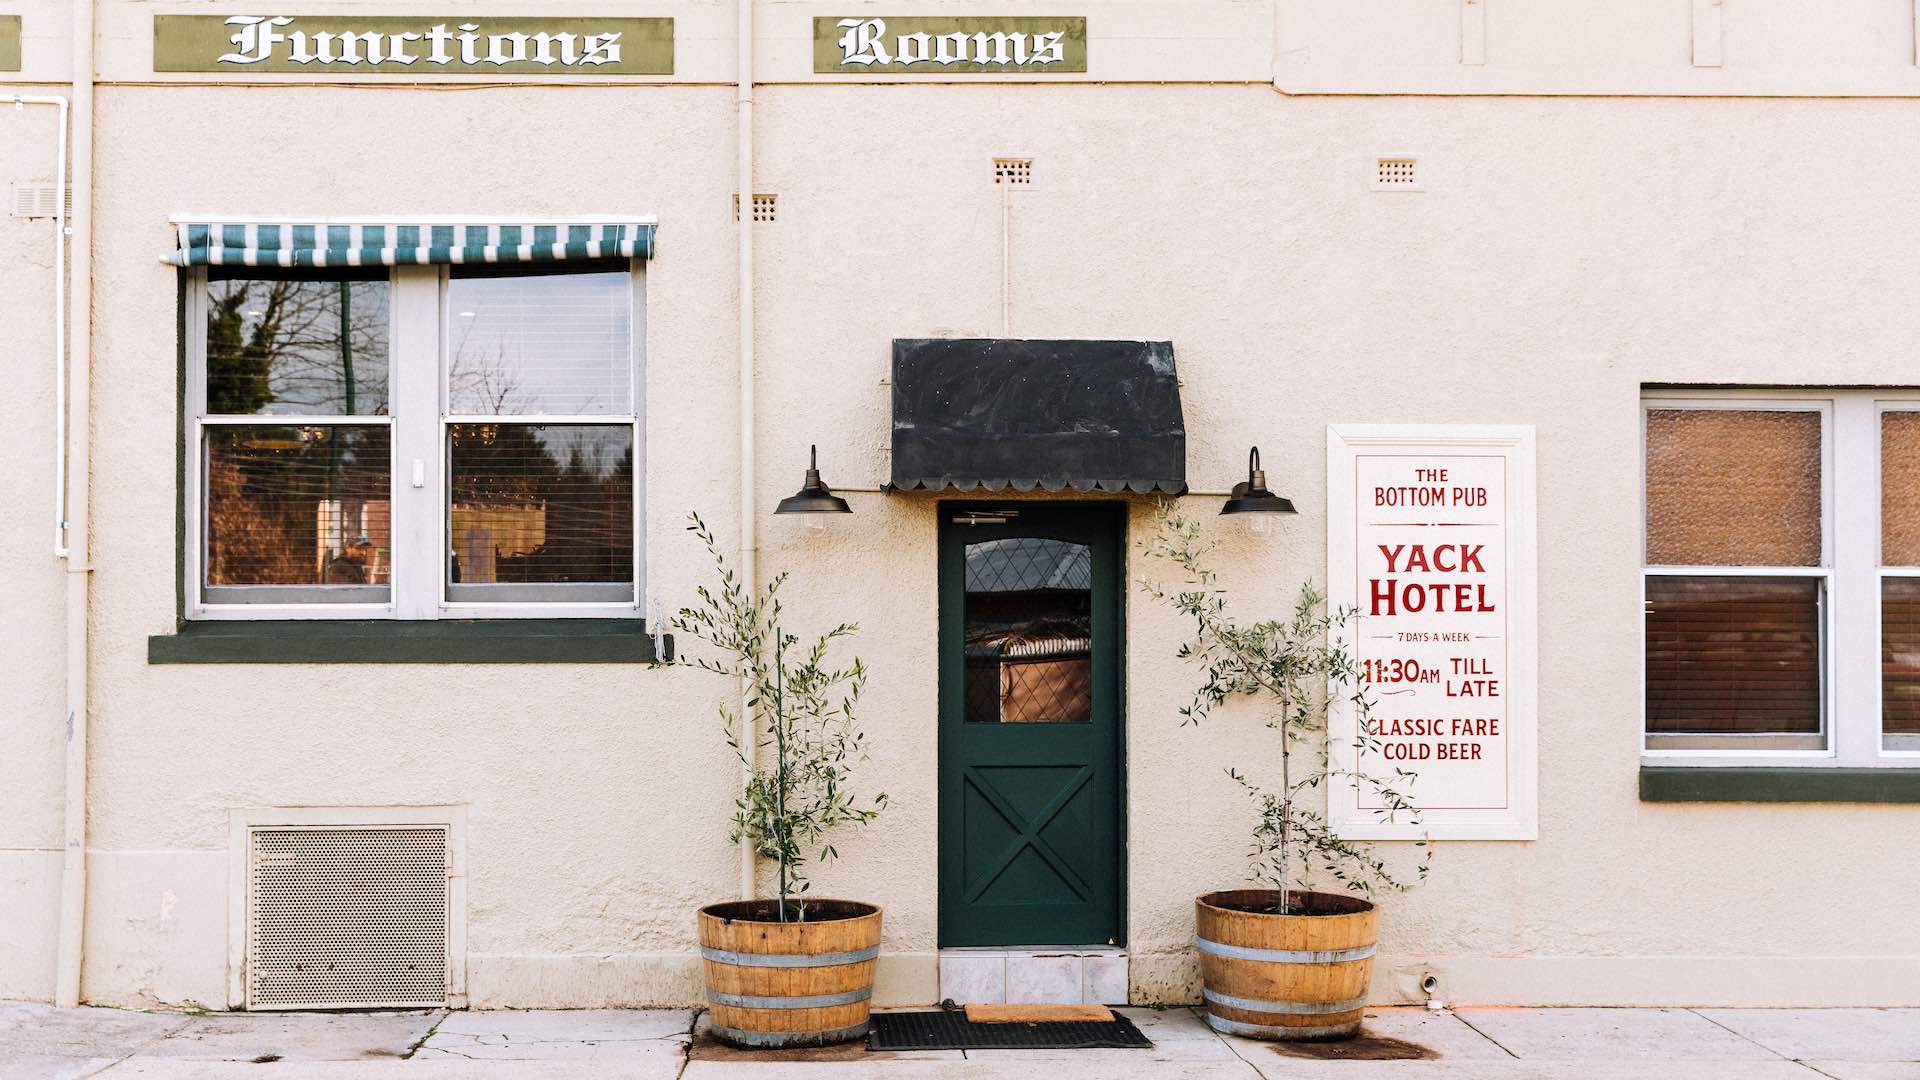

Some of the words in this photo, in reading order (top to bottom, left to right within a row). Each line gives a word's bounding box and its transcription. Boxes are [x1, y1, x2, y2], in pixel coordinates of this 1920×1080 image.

[217, 16, 622, 65] Functions
[836, 17, 1065, 66] Rooms
[1415, 469, 1449, 482] THE
[1375, 487, 1445, 507] BOTTOM
[1453, 487, 1488, 507] PUB
[1378, 544, 1486, 573] YACK
[1369, 579, 1496, 616] HOTEL
[1398, 633, 1404, 642] 7
[1406, 633, 1429, 642] DAYS
[1433, 633, 1440, 642] A
[1442, 632, 1470, 642] WEEK
[1450, 658, 1493, 675] TILL
[1446, 680, 1500, 697] LATE
[1367, 719, 1444, 736] CLASSIC
[1451, 719, 1500, 736] FARE
[1383, 743, 1431, 760] COLD
[1437, 743, 1482, 760] BEER
